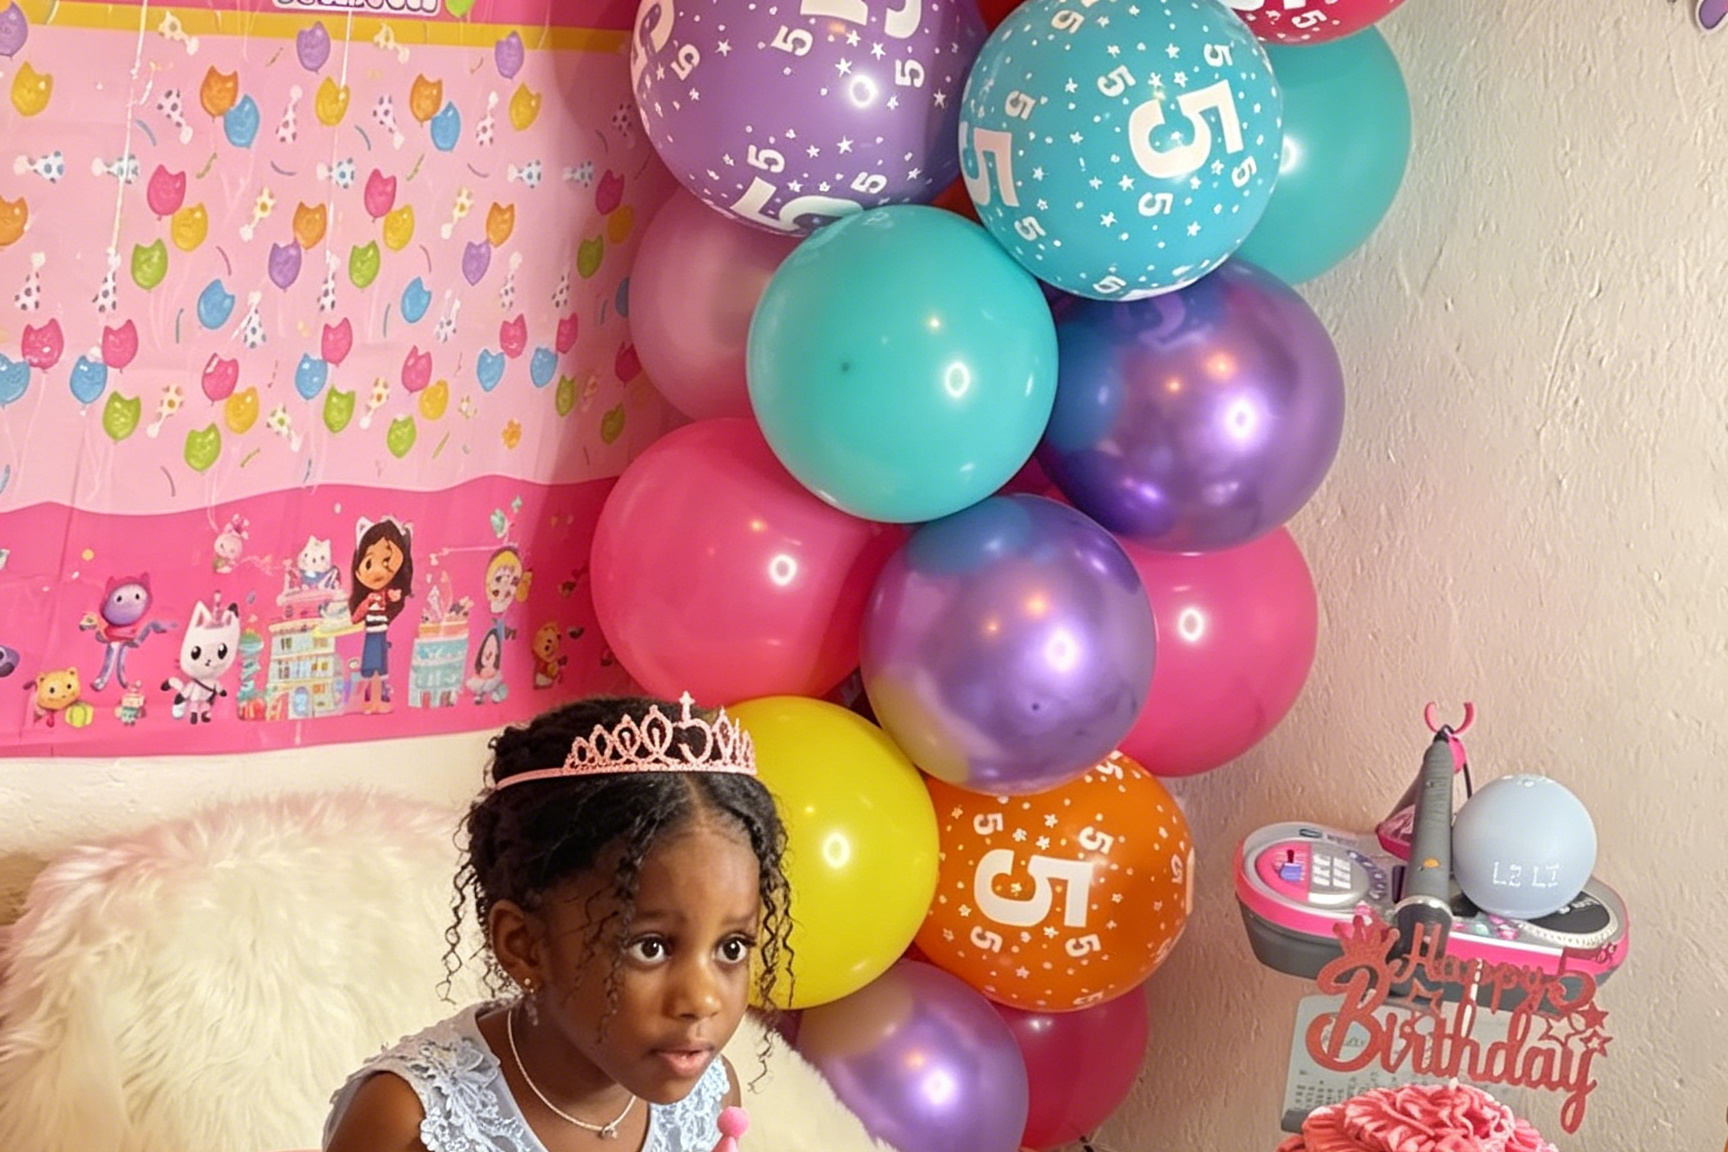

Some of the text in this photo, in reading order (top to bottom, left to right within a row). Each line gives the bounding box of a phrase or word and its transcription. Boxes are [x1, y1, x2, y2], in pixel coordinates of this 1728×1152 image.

[1291, 10, 1327, 28] 5
[771, 25, 813, 56] 5
[671, 44, 700, 80] 5
[1203, 43, 1233, 67] 5
[895, 59, 924, 87] 5
[1097, 65, 1135, 97] 5
[1004, 90, 1036, 121] 5
[1128, 79, 1244, 179] 5
[748, 145, 785, 173] 5
[958, 121, 1020, 208] 5
[1231, 156, 1257, 189] 5
[851, 171, 887, 194] 5
[1138, 192, 1174, 217] 5
[1014, 216, 1046, 242] 5
[973, 813, 1003, 836] 5
[1078, 826, 1114, 854] 5
[974, 848, 1093, 928] 5
[970, 926, 1003, 953] 5
[1065, 933, 1101, 957] 5
[1391, 922, 1546, 1014] Happy
[1305, 957, 1598, 1135] Birthday
